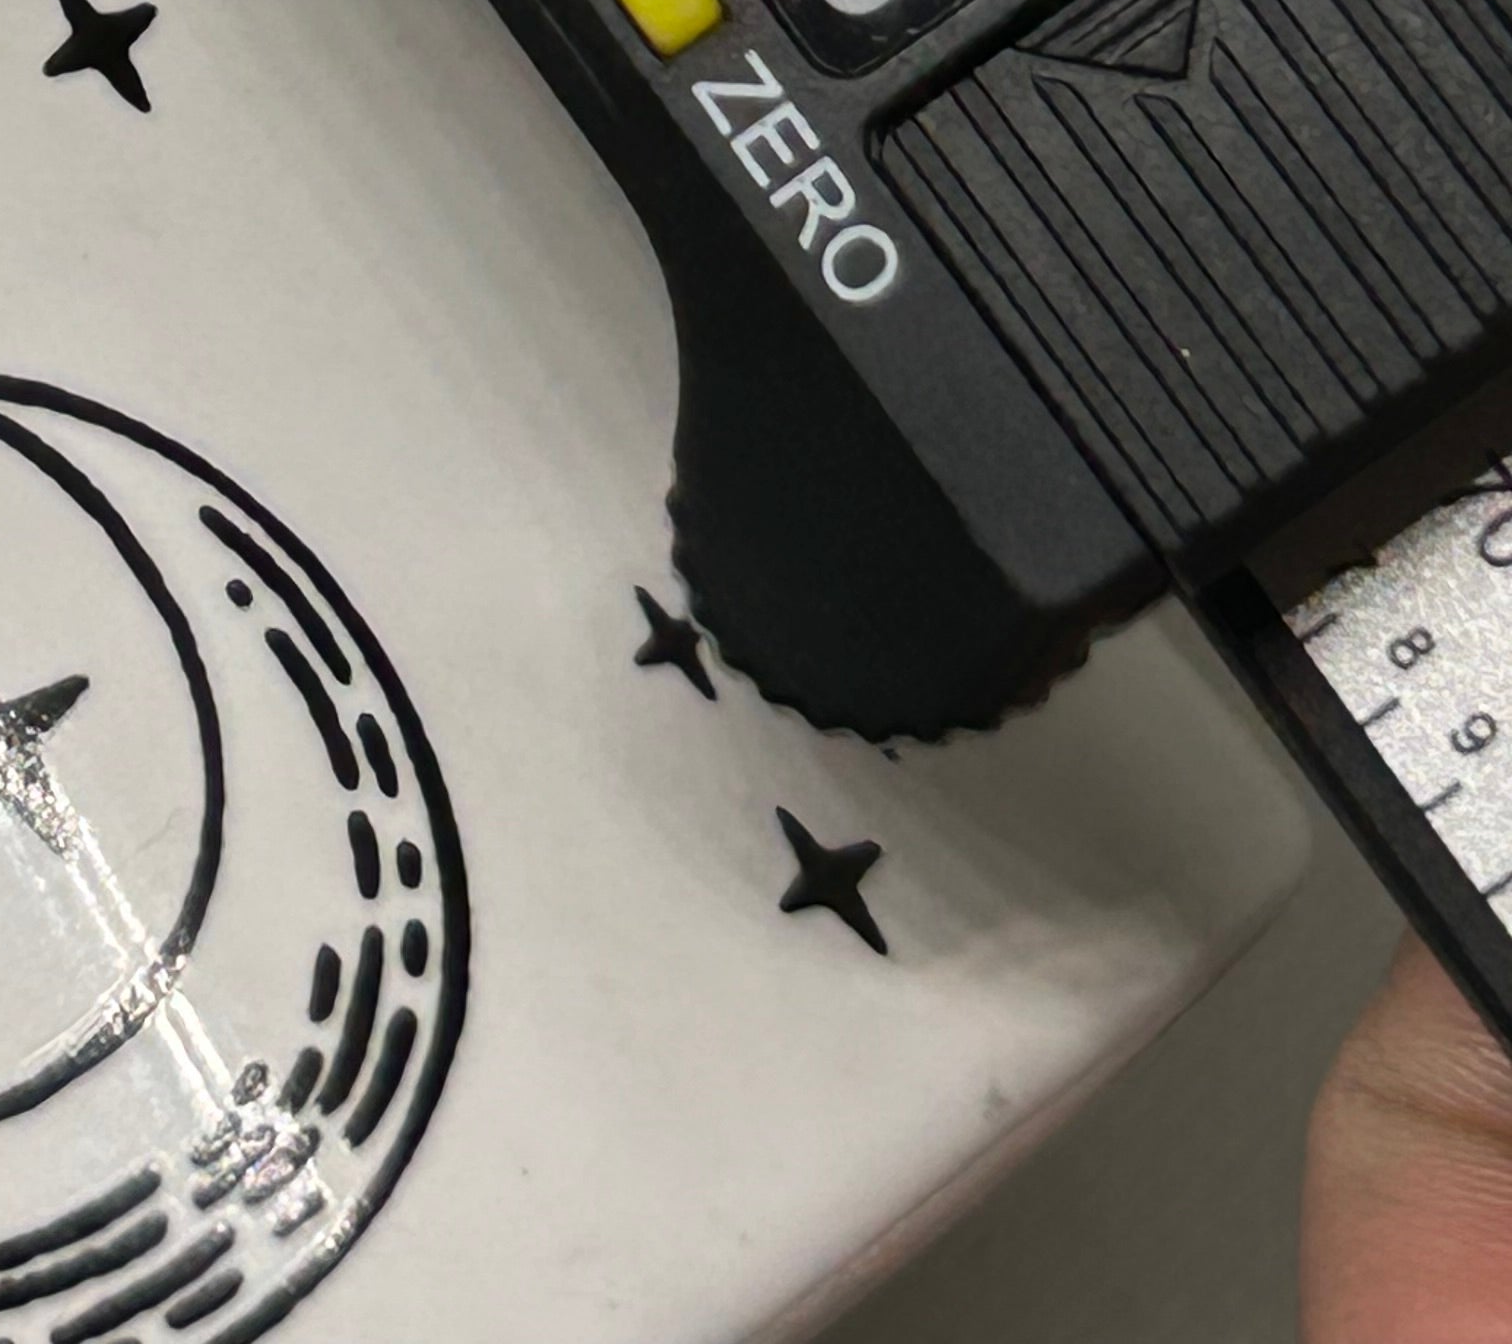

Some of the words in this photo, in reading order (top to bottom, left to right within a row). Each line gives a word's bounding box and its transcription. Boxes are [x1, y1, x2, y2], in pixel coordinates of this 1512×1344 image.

[690, 48, 900, 303] ZERO
[1387, 625, 1436, 671] 8
[1450, 711, 1498, 757] 9
